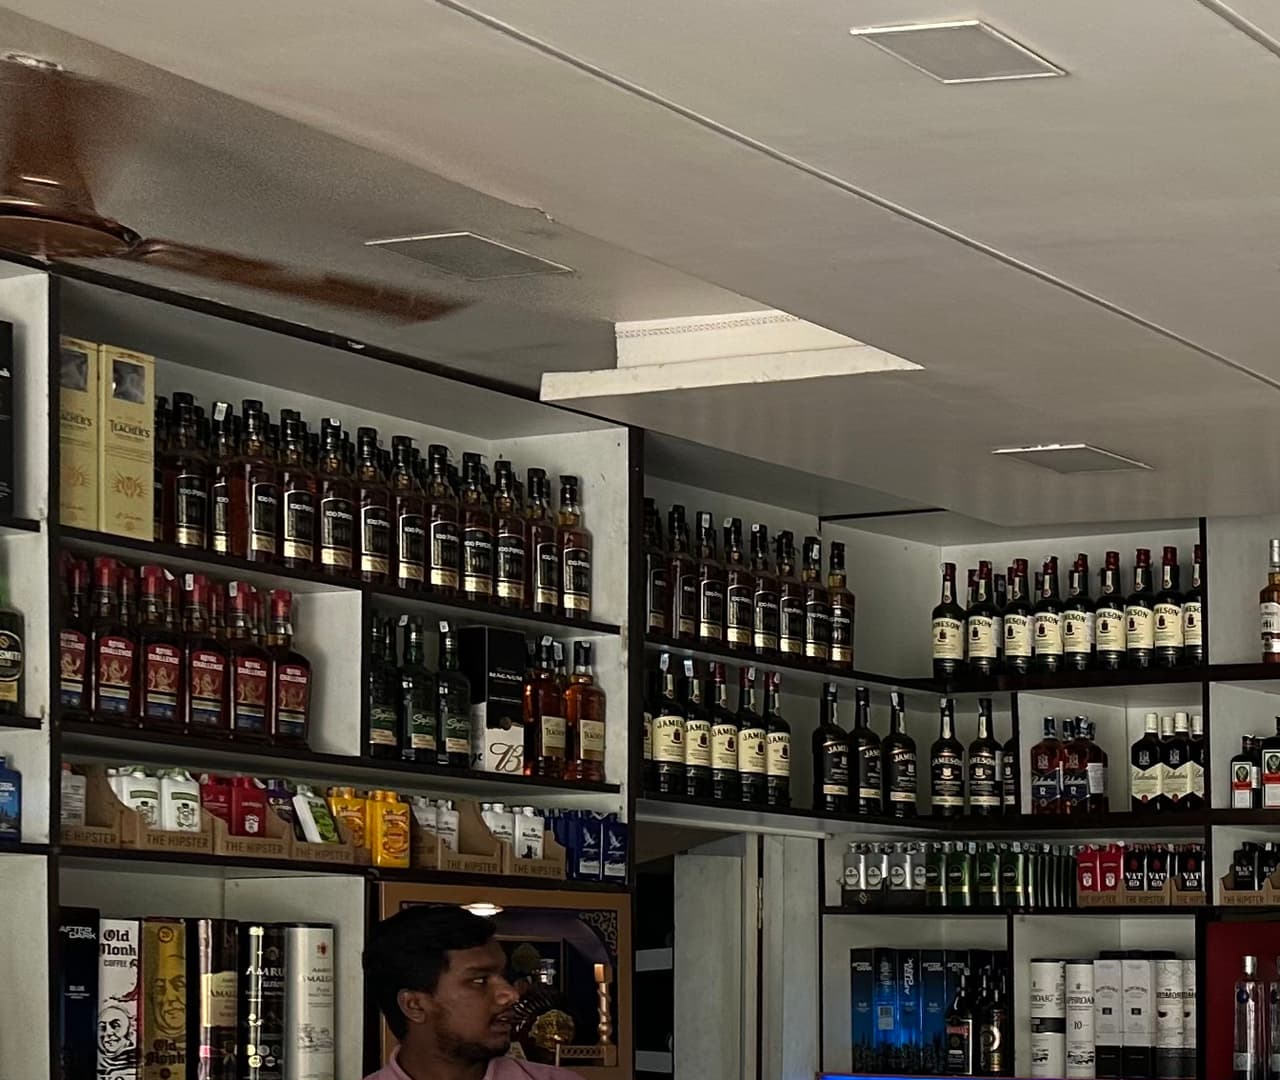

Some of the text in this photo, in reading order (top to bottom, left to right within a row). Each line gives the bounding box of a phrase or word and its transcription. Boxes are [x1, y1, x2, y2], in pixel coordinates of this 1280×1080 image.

[146, 833, 209, 848] THE HIPSTER
[1125, 871, 1143, 880] VAT
[1148, 871, 1168, 880] VAT
[1184, 871, 1202, 880] VAT
[103, 929, 130, 943] Old
